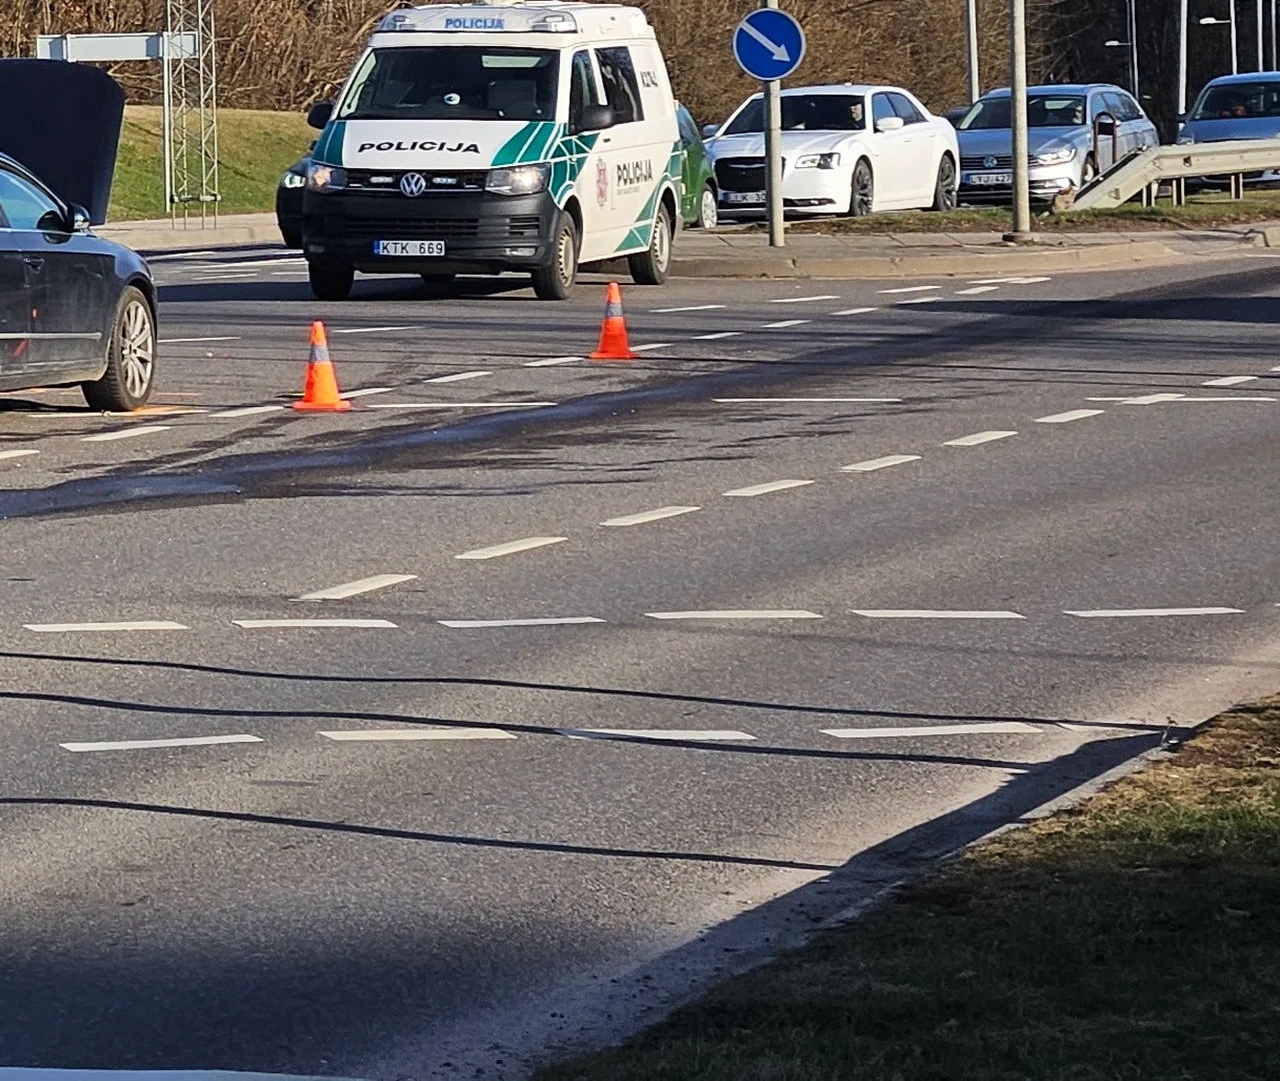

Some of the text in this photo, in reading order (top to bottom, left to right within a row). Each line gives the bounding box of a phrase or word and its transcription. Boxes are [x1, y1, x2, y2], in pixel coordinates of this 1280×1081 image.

[444, 17, 505, 30] POLICIJA
[357, 141, 481, 154] POLICIJA
[616, 158, 654, 187] POLICIJA
[381, 241, 443, 255] KTK 669
